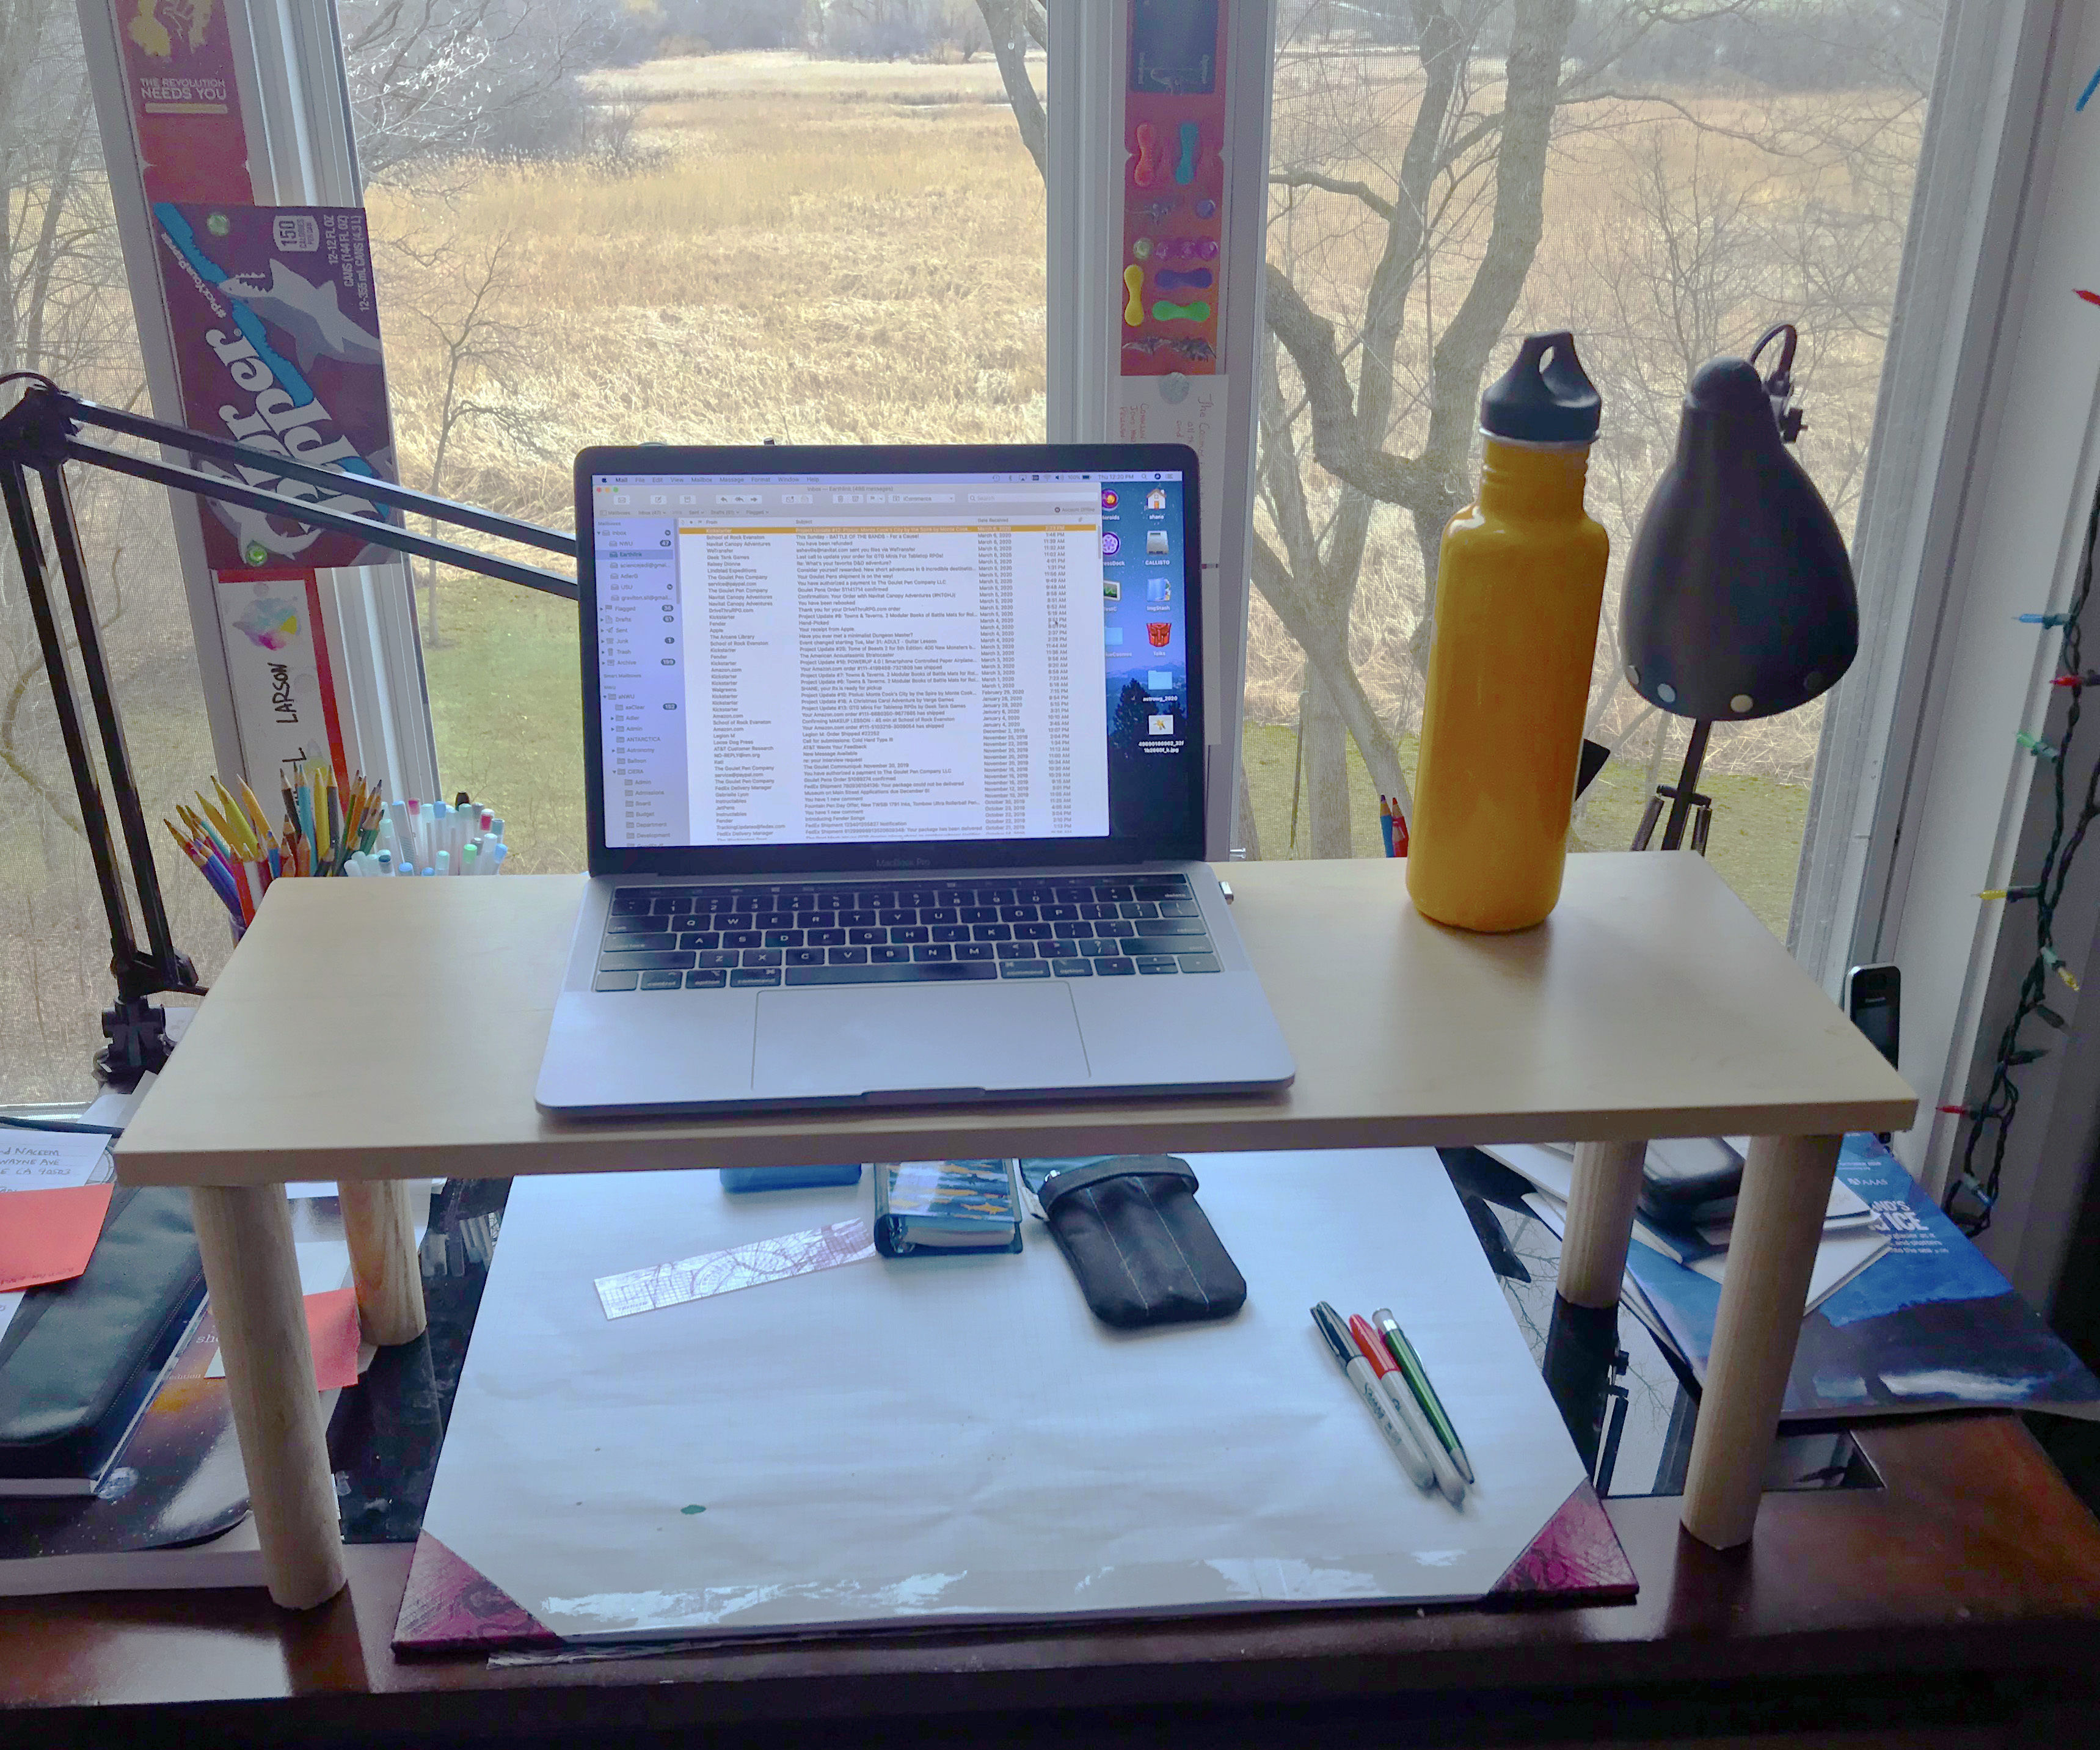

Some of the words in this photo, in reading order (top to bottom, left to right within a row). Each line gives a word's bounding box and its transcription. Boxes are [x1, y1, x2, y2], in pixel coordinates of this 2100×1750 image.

[140, 88, 192, 99] NEEDS
[196, 88, 227, 100] YOU
[162, 78, 225, 87] REVOLUTION
[324, 214, 335, 227] OZ
[279, 221, 297, 246] 150
[326, 239, 338, 265] 12-12
[353, 242, 365, 266] CANS
[342, 263, 354, 287] CANS
[268, 662, 298, 723] LARSON
